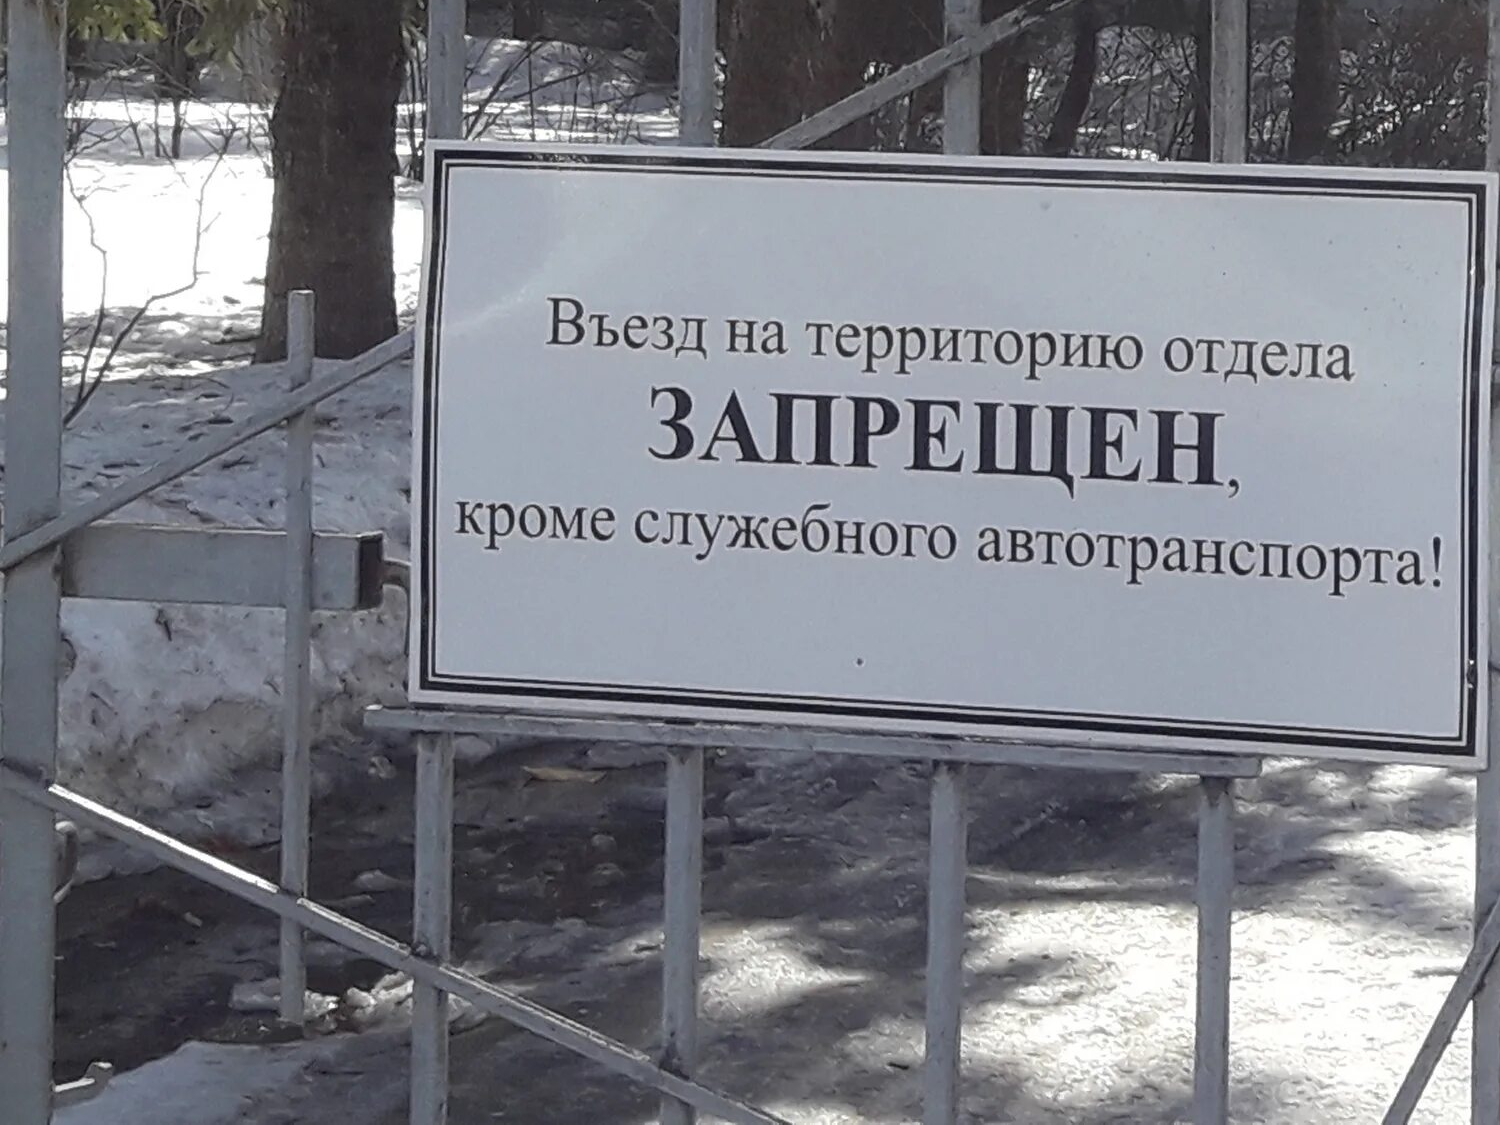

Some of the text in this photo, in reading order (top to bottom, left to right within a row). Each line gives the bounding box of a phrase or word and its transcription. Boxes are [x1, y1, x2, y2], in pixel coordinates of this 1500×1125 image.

[545, 296, 1355, 385] Въезд на территорию отдела
[647, 386, 1241, 501] ЗАПРЕЩЕН,
[454, 499, 1445, 598] кроме служебного автотранспорта!
